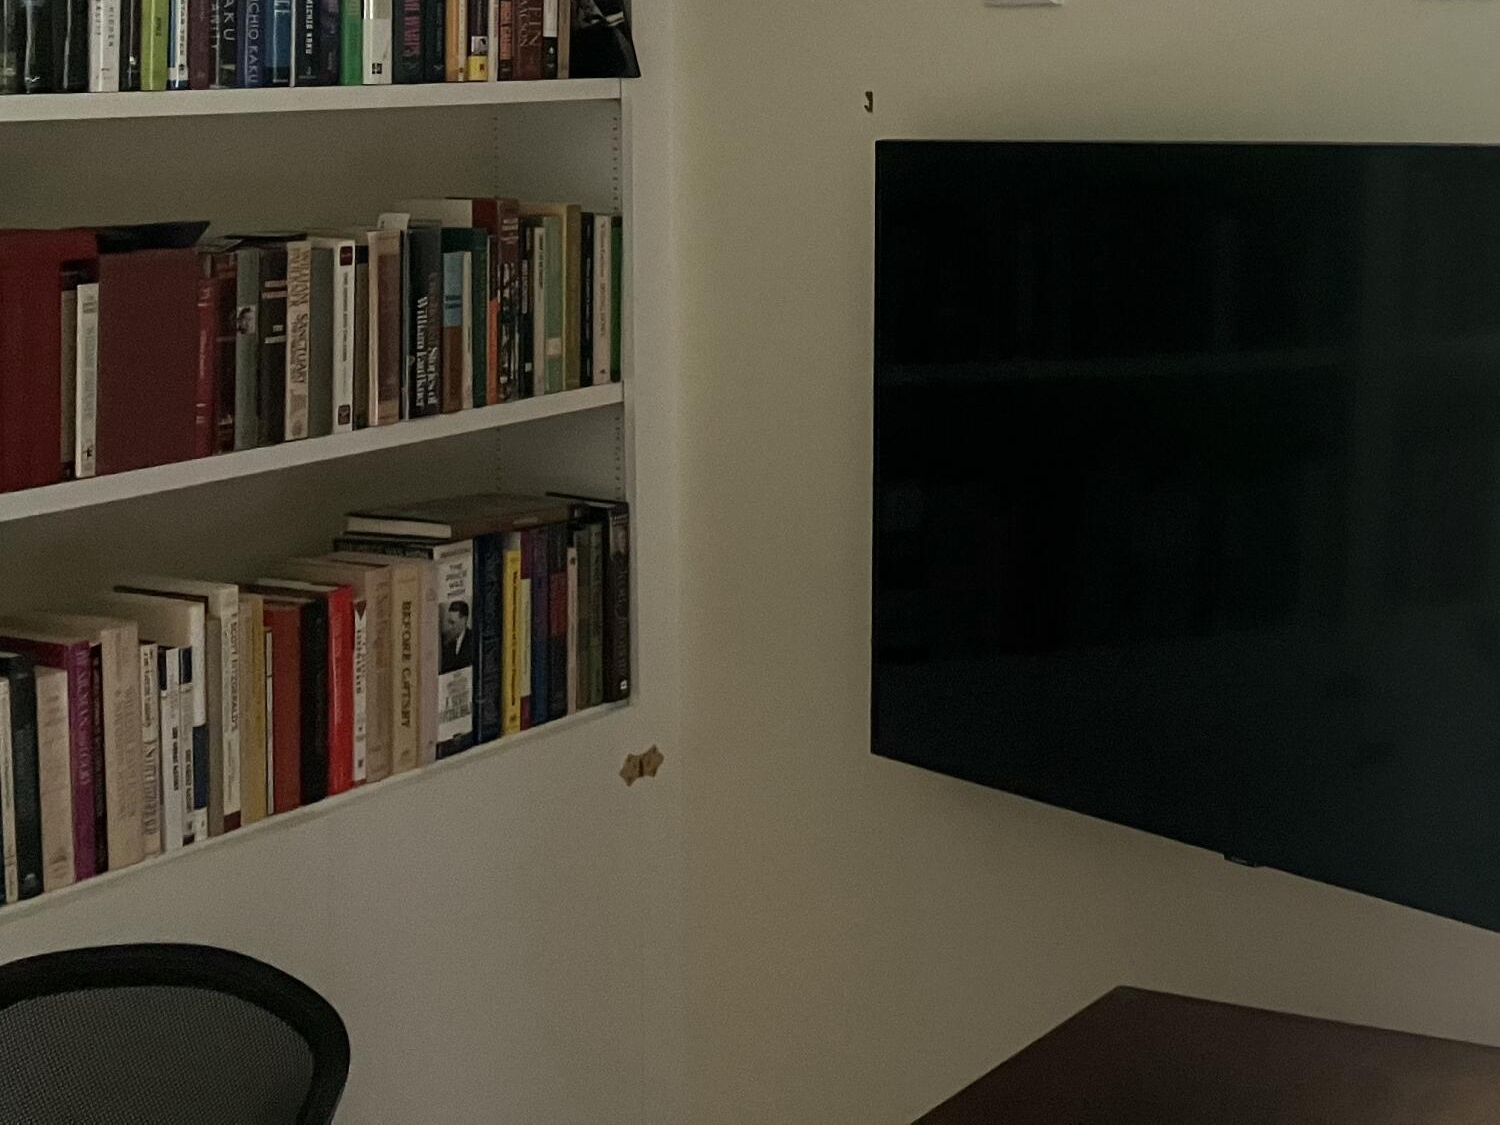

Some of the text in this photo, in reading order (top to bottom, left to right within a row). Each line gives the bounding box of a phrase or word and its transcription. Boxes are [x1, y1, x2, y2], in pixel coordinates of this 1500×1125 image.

[108, 5, 116, 49] HIDDEN
[248, 45, 260, 83] KAKU
[294, 311, 308, 385] SANCTUARY
[400, 601, 412, 729] BEFORE GATSBY
